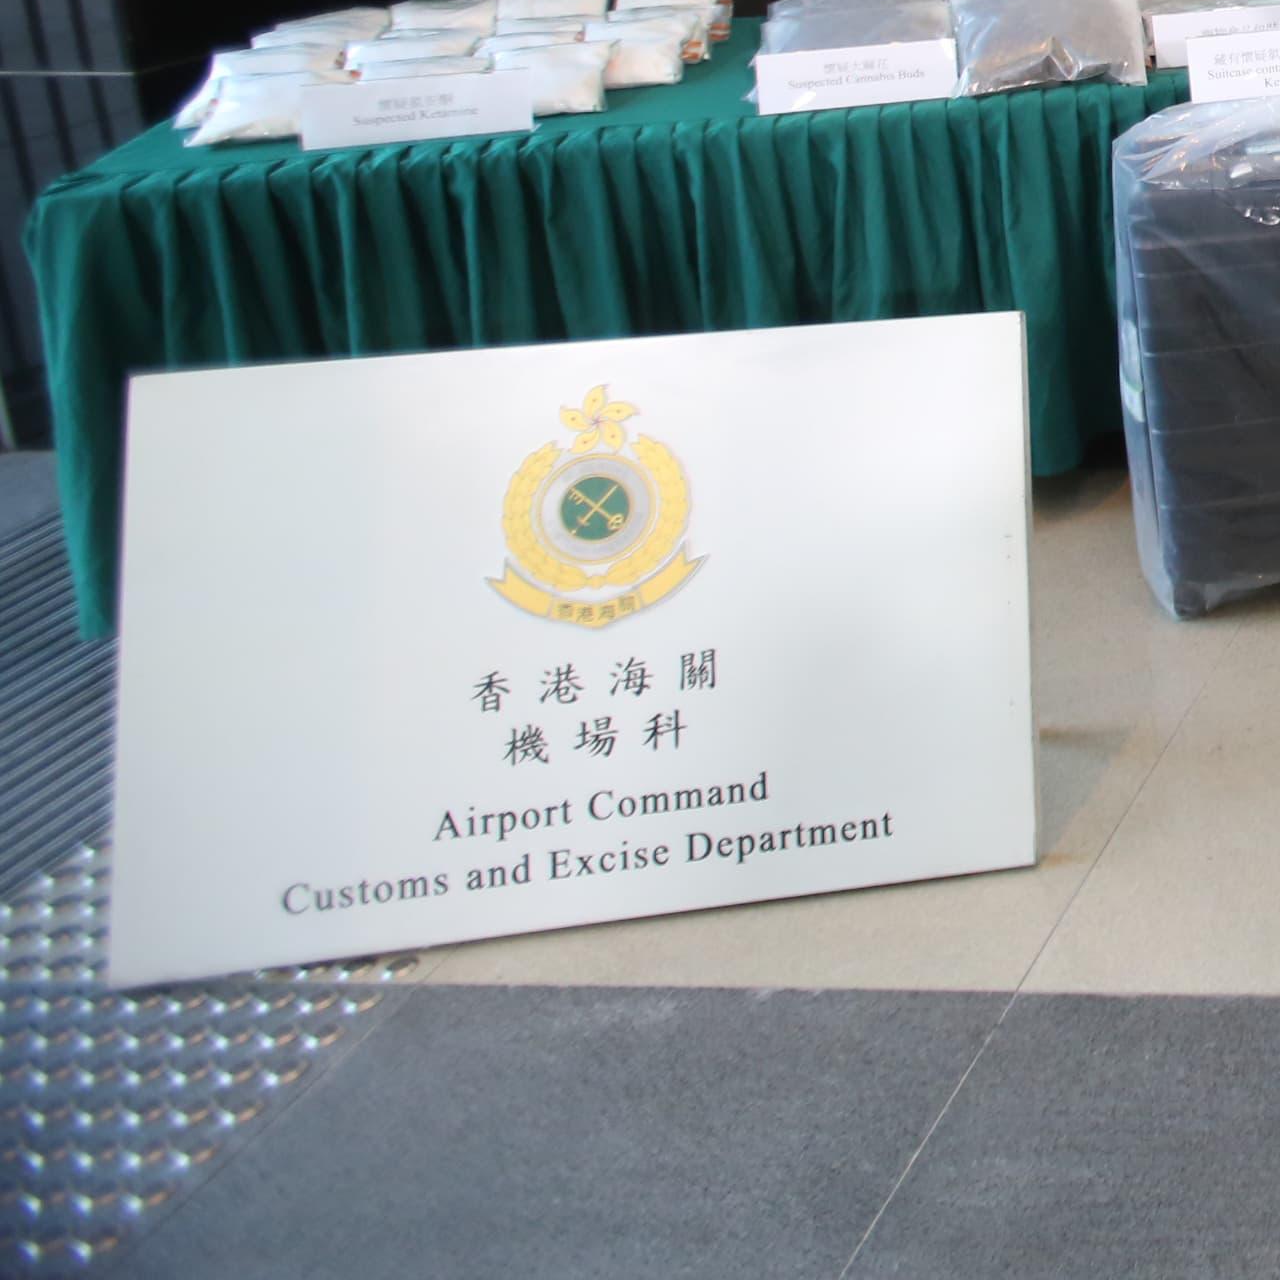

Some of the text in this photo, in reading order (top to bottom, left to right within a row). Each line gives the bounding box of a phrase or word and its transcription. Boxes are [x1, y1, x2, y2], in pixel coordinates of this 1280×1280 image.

[1208, 67, 1251, 81] Suitcase
[471, 649, 719, 714] 香港海關
[502, 709, 688, 767] 機場科
[433, 771, 770, 842] Airport Command
[281, 811, 894, 915] Customs and Excise Department
